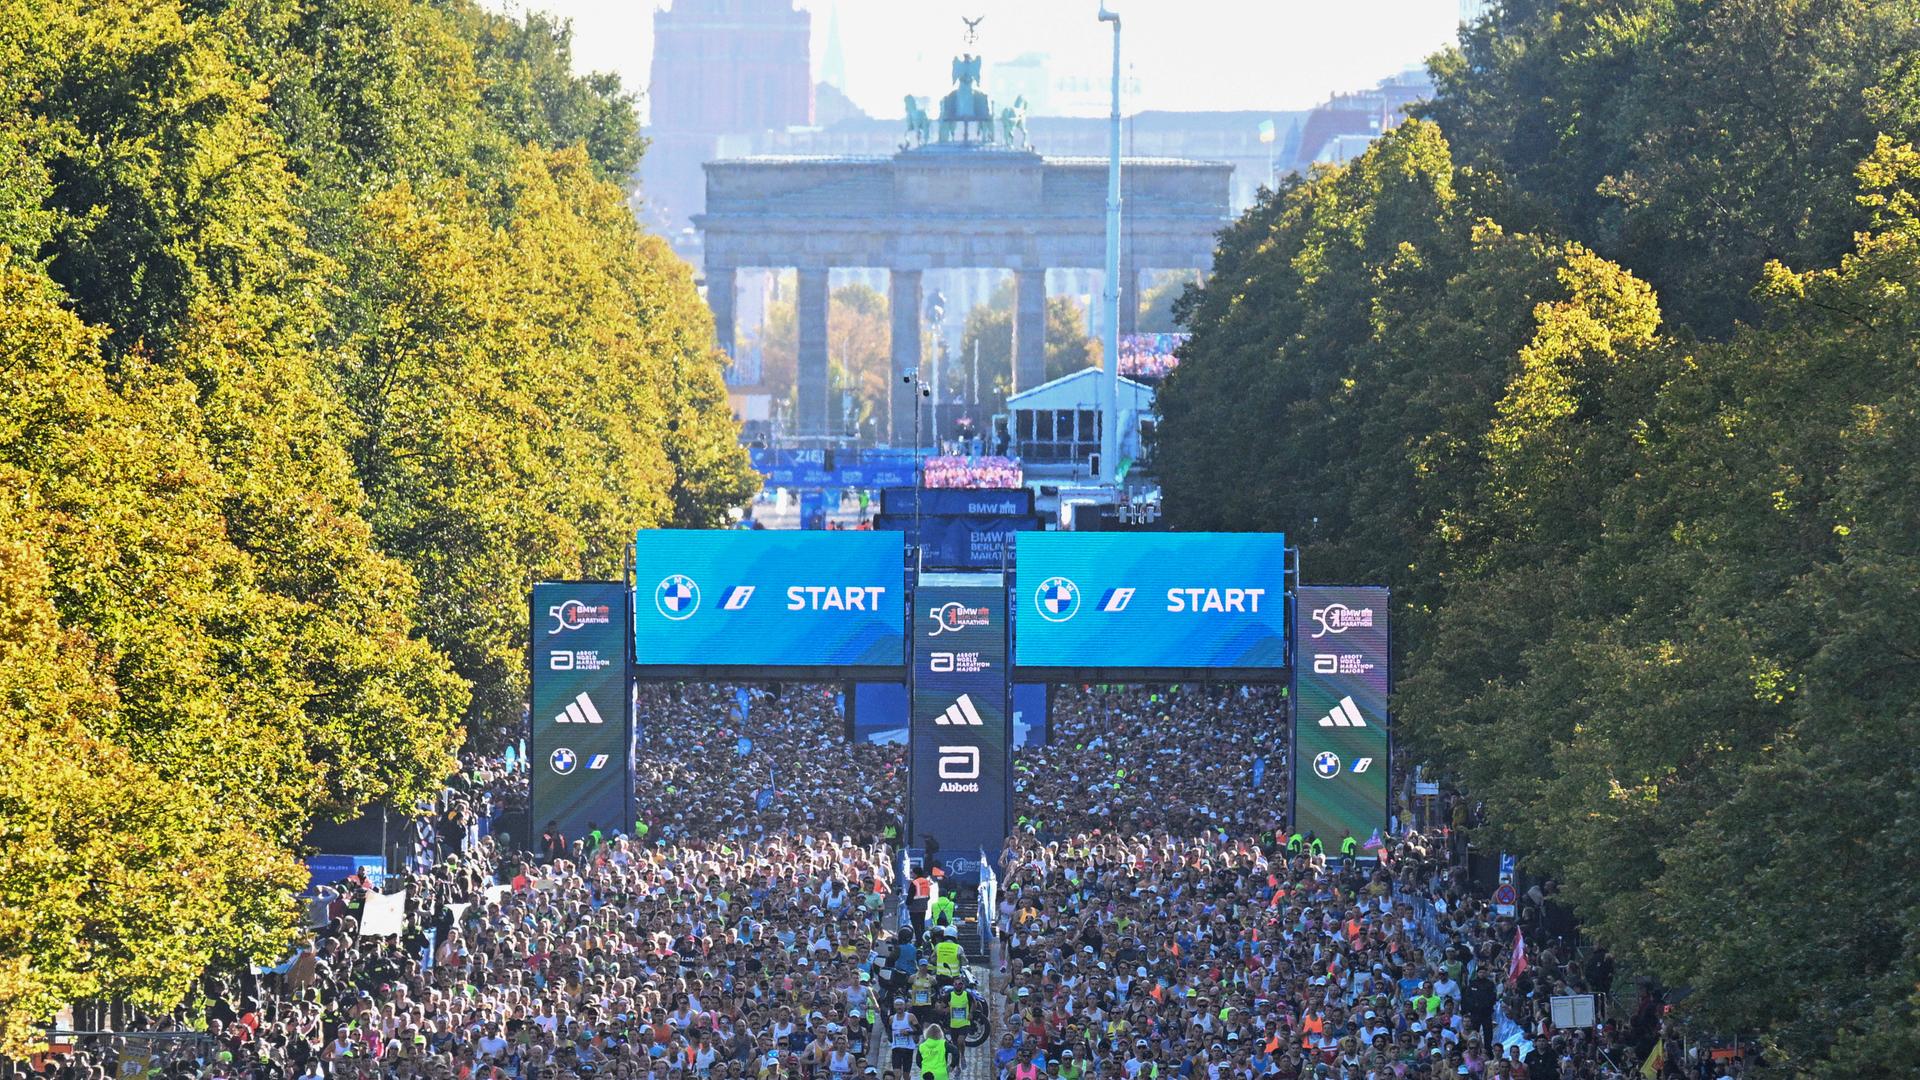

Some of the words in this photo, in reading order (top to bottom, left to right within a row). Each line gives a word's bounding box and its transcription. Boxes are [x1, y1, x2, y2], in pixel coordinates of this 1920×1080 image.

[968, 503, 998, 513] BMW
[970, 532, 1004, 542] BMW
[970, 543, 1004, 551] BERLIN
[786, 586, 886, 611] START
[1166, 587, 1265, 613] START
[576, 606, 597, 614] BMW
[957, 608, 978, 616] BMW
[1340, 609, 1361, 617] BMW
[548, 600, 585, 634] 50
[928, 602, 965, 636] 50
[1311, 603, 1348, 639] 50
[939, 782, 979, 793] Abbott
